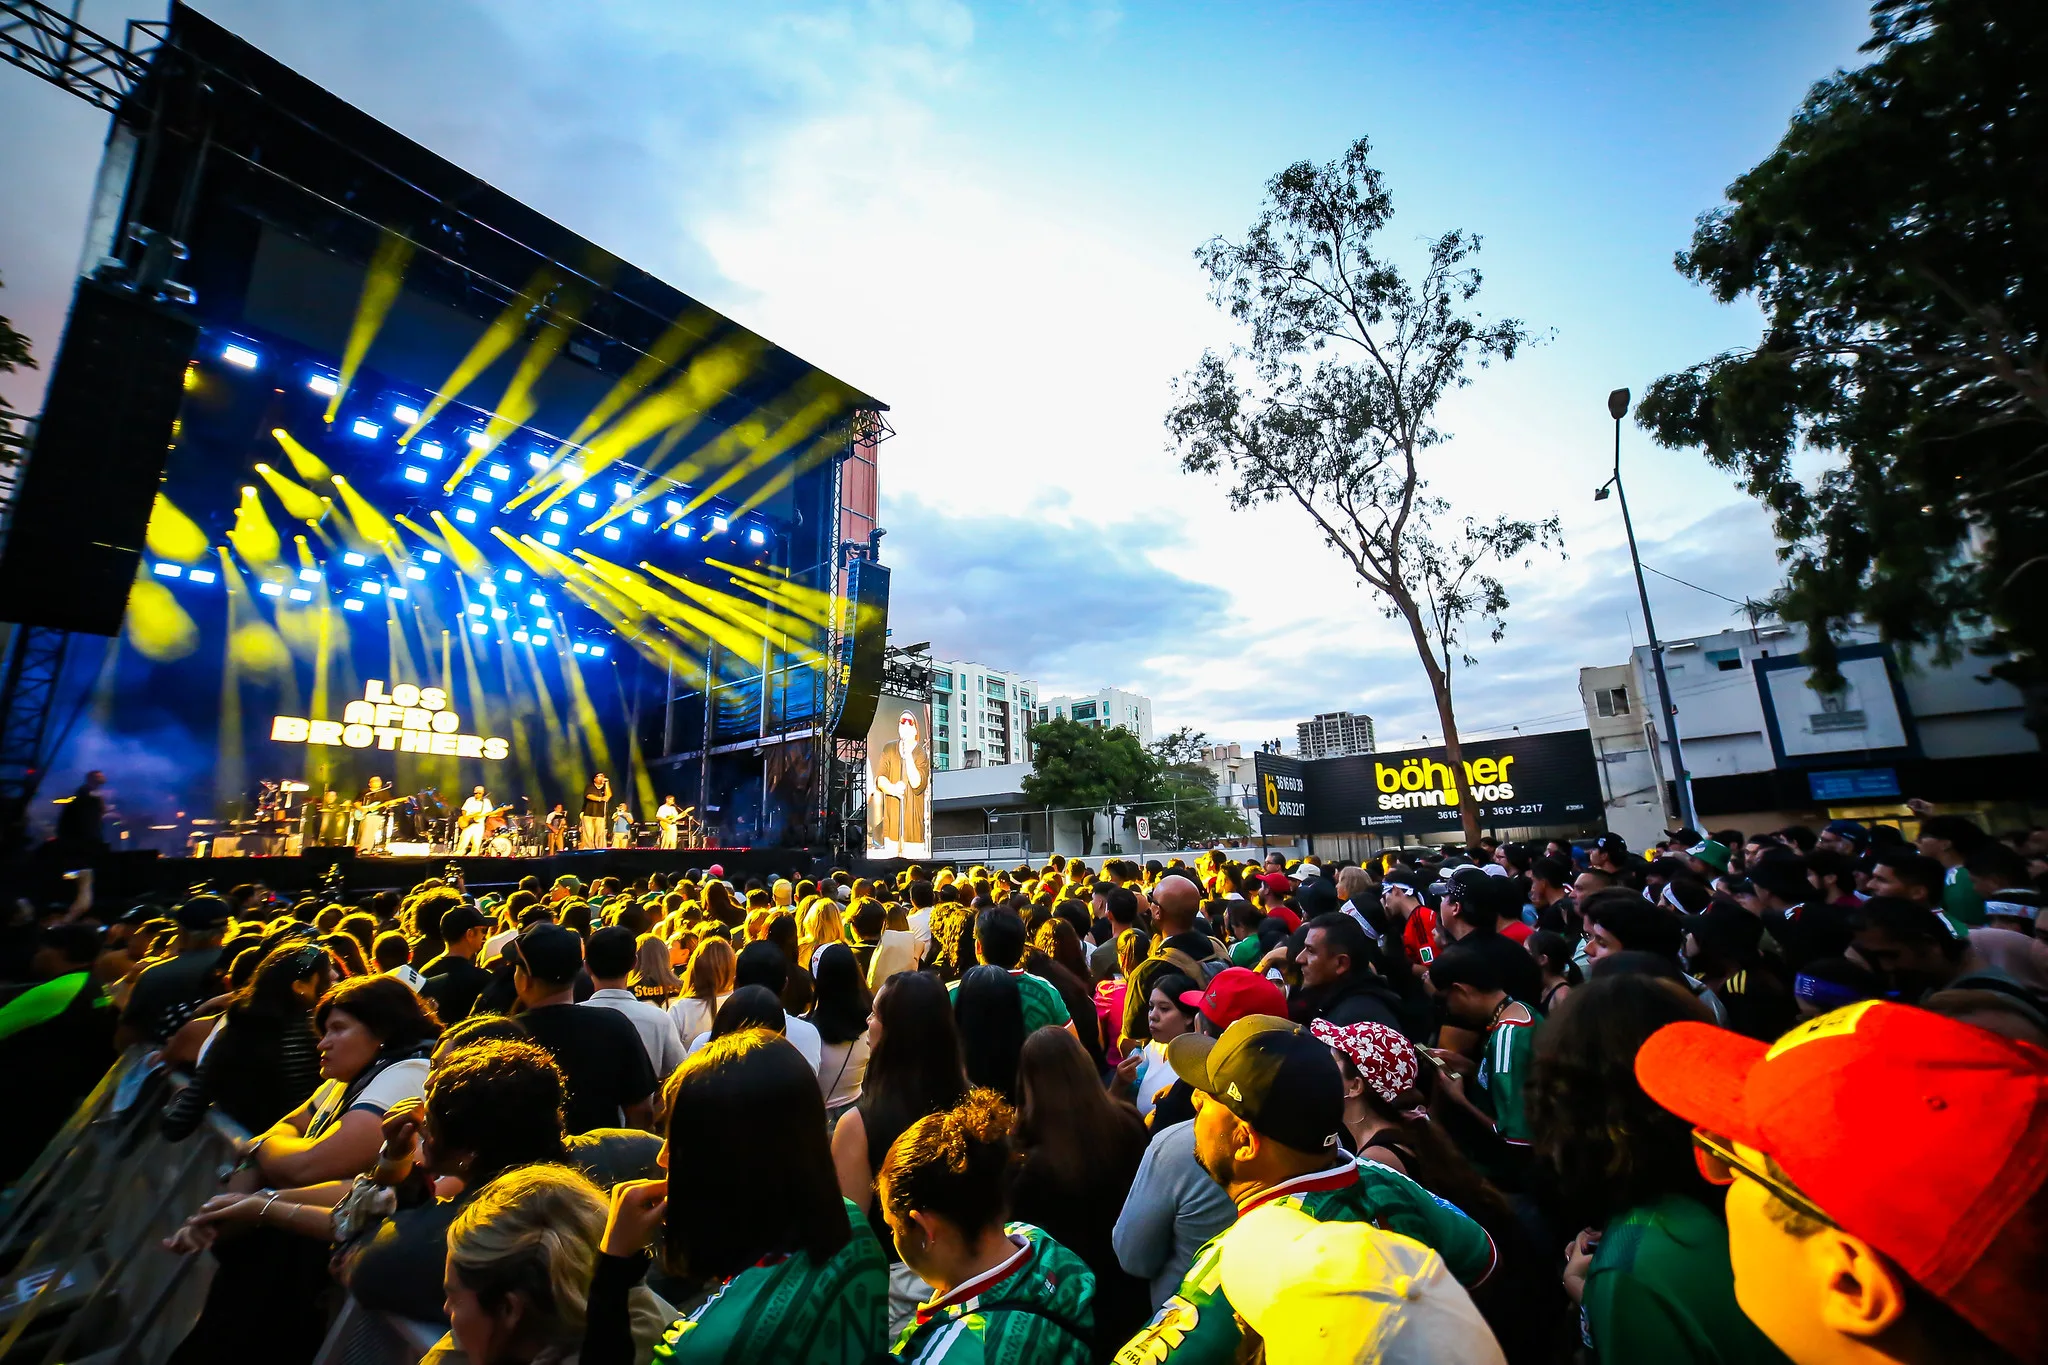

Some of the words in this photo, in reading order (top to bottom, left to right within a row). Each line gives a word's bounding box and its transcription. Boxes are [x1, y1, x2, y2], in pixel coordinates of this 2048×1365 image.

[364, 678, 448, 711] LOS
[343, 699, 460, 734] AFRO
[270, 715, 509, 760] BROTHERS
[1378, 783, 1515, 811] seminuvos
